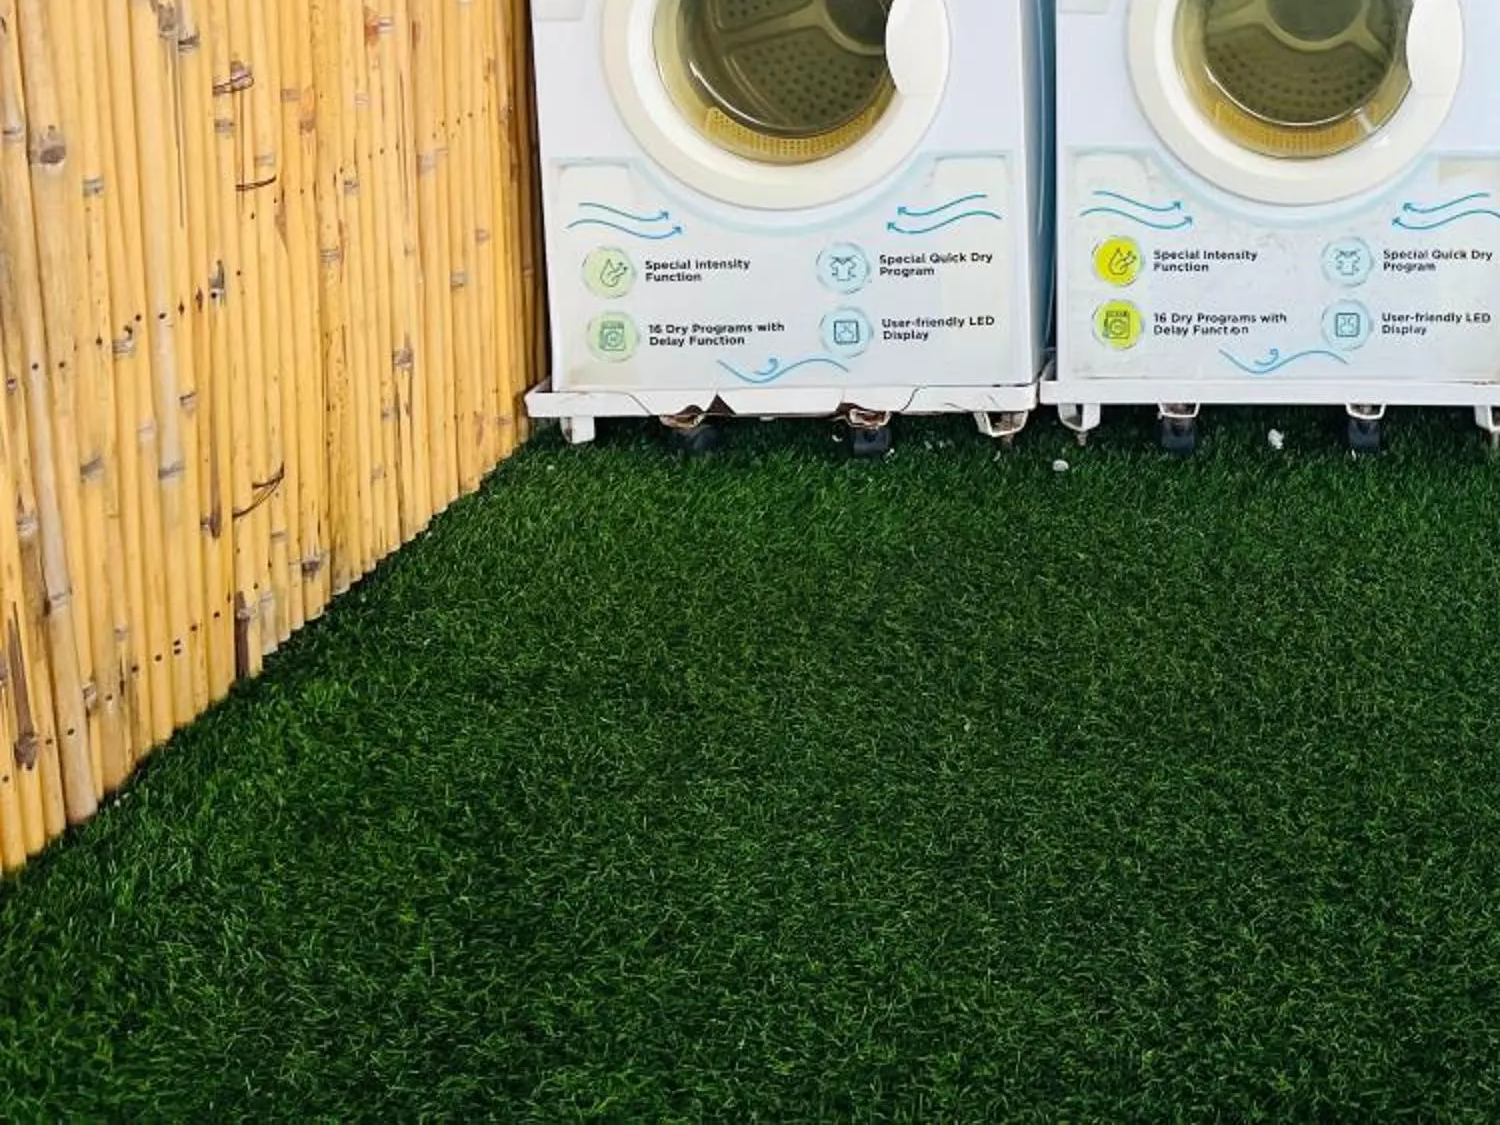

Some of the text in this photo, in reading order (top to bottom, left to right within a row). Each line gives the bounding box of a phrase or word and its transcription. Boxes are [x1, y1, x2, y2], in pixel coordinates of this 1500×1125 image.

[879, 252, 993, 266] Special Quick Dry
[1153, 250, 1258, 261] Special Intensity
[1383, 249, 1493, 261] Special Quick Dry
[645, 259, 691, 271] Special
[1153, 261, 1209, 272] Function
[1383, 262, 1436, 273] Program
[645, 272, 702, 282] Function
[879, 266, 935, 278] Program
[881, 316, 995, 328] User-friendly LED
[1153, 312, 1287, 324] 16 Dry Programs with
[1381, 312, 1491, 324] User-friendly LED
[648, 322, 785, 335] 16 Dry Programs with
[1153, 324, 1249, 337] Delay Function
[1381, 324, 1427, 335] Display
[649, 335, 745, 347] Delay Function
[883, 330, 929, 341] Display
